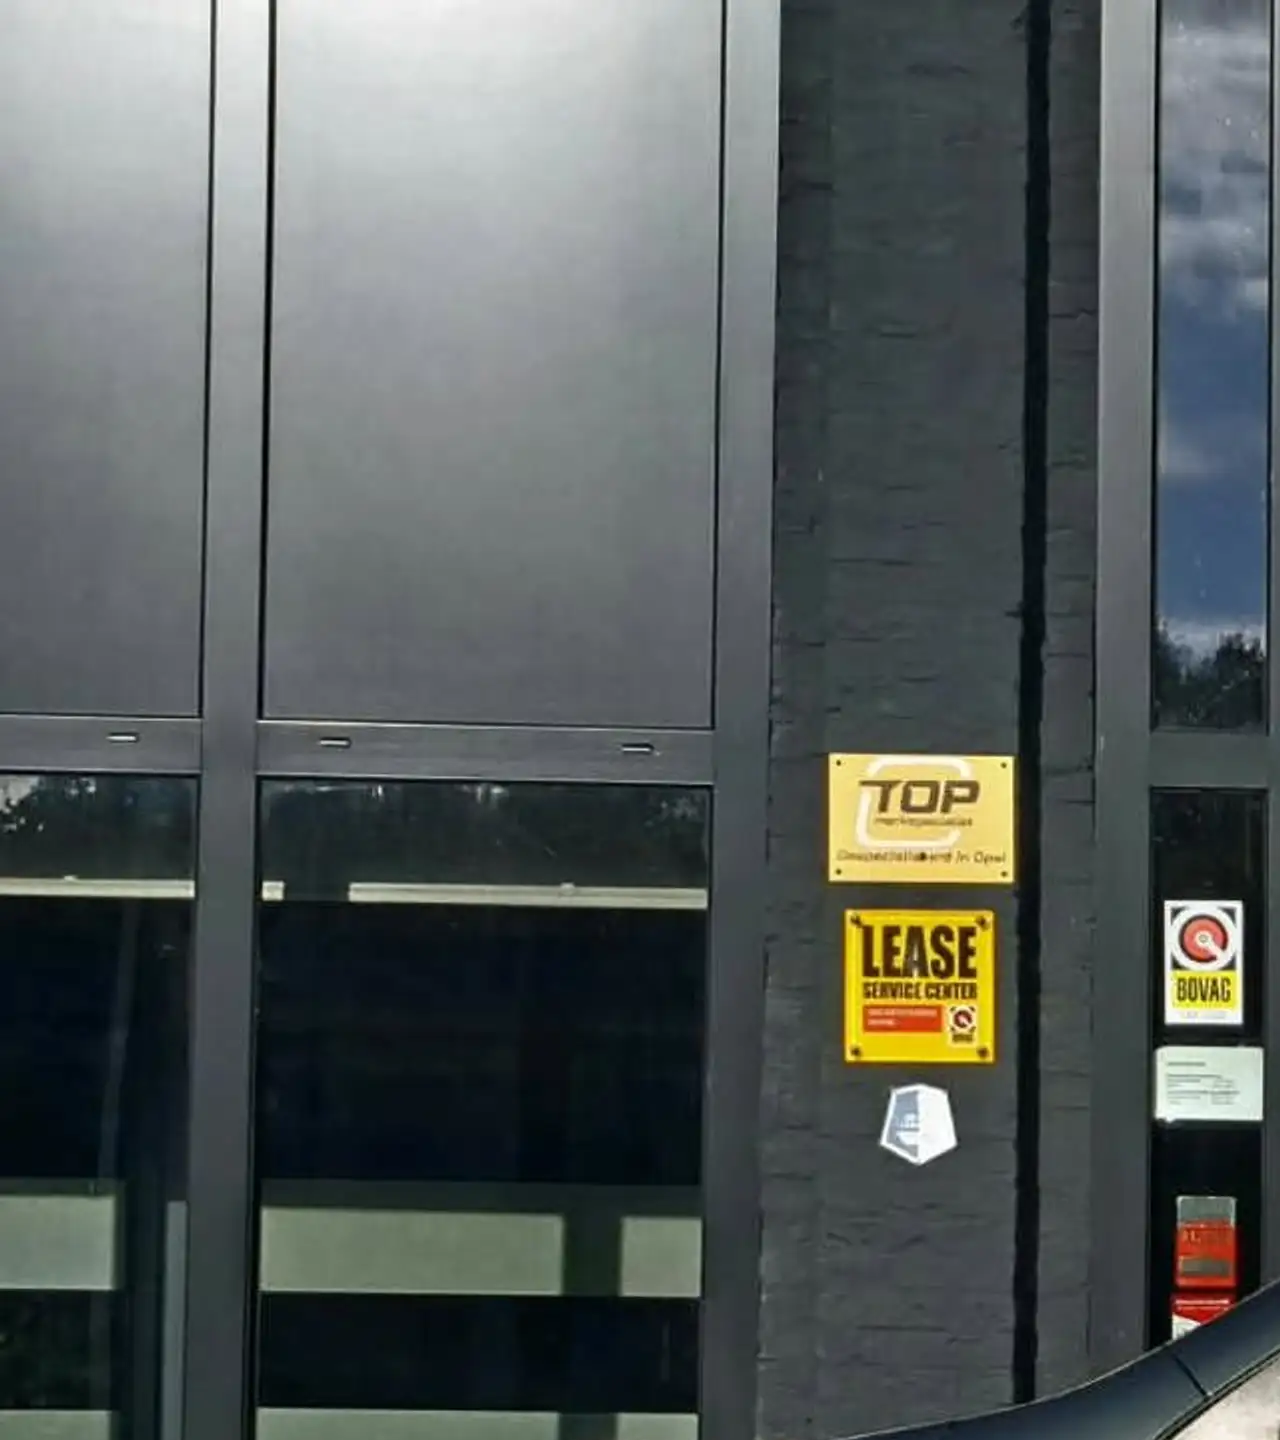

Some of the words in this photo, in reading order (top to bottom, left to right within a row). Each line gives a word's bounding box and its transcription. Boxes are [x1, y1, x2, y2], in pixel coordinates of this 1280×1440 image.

[858, 779, 980, 813] TOP
[862, 923, 978, 980] LEASE
[863, 981, 923, 1000] SERVICE
[924, 981, 978, 1001] CENTER
[1177, 976, 1232, 1003] BOVAG
